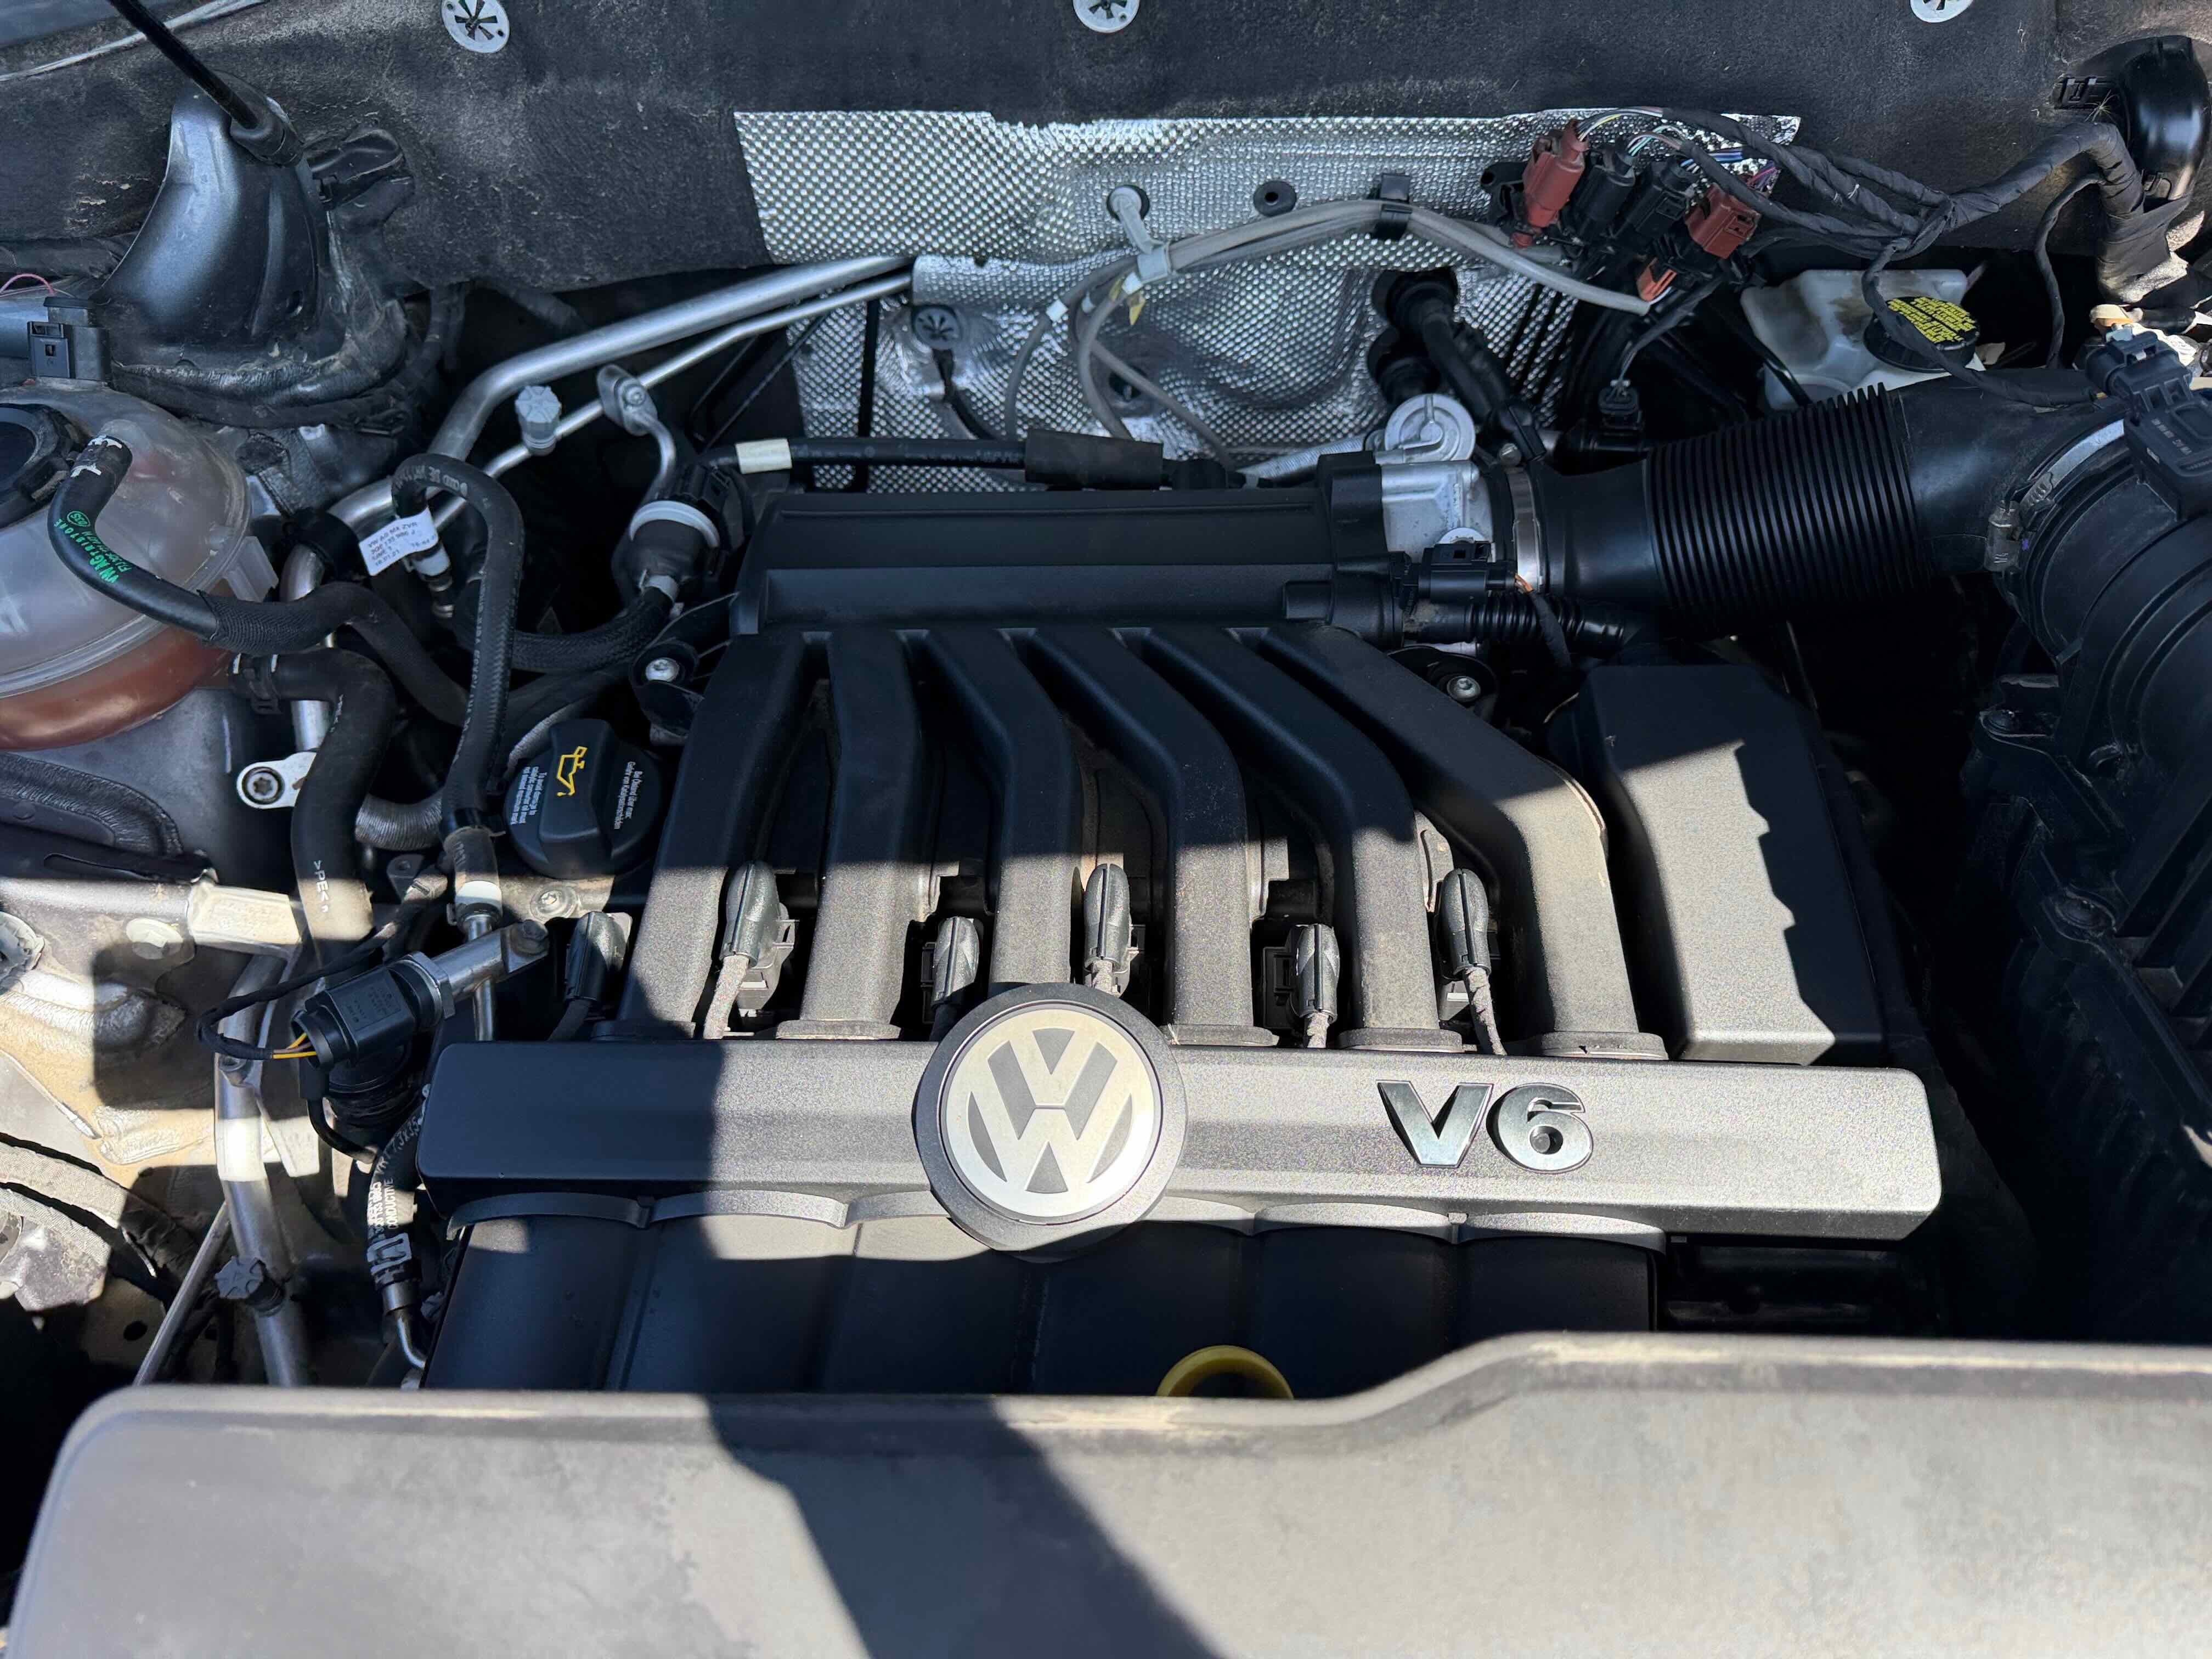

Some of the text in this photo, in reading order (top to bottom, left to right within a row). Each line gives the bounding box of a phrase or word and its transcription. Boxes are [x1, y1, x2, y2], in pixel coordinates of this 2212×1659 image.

[949, 1014, 1153, 1212] VW
[1376, 1079, 1594, 1174] V6
[384, 1177, 398, 1229] CONDUCTIVE
